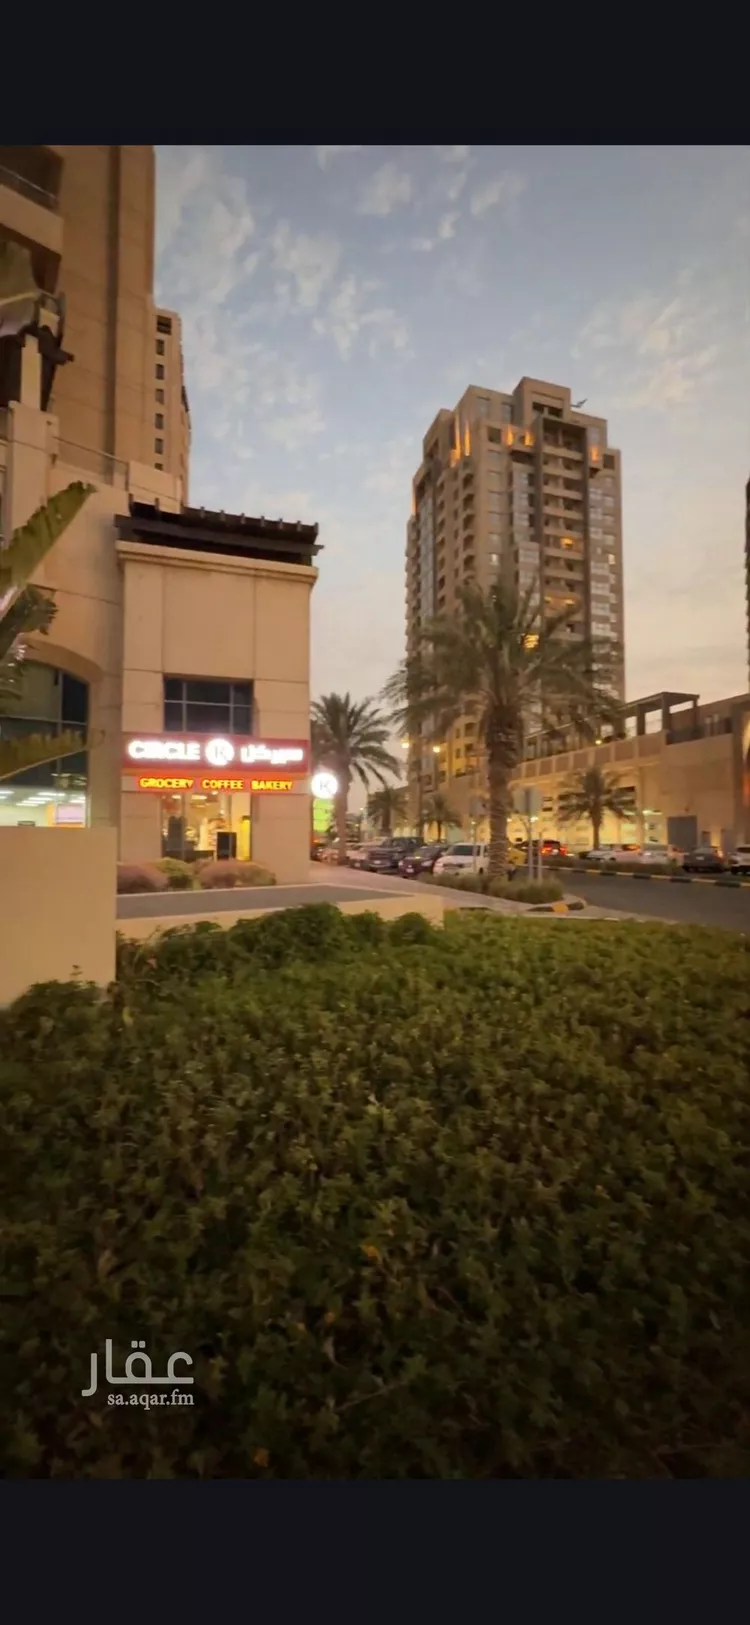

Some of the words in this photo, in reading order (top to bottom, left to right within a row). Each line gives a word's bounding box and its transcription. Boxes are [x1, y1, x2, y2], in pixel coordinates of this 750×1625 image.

[128, 740, 201, 760] CIRCLE
[139, 777, 194, 789] GROCERY
[202, 779, 244, 790] COFFEE
[251, 780, 293, 791] BAKERY
